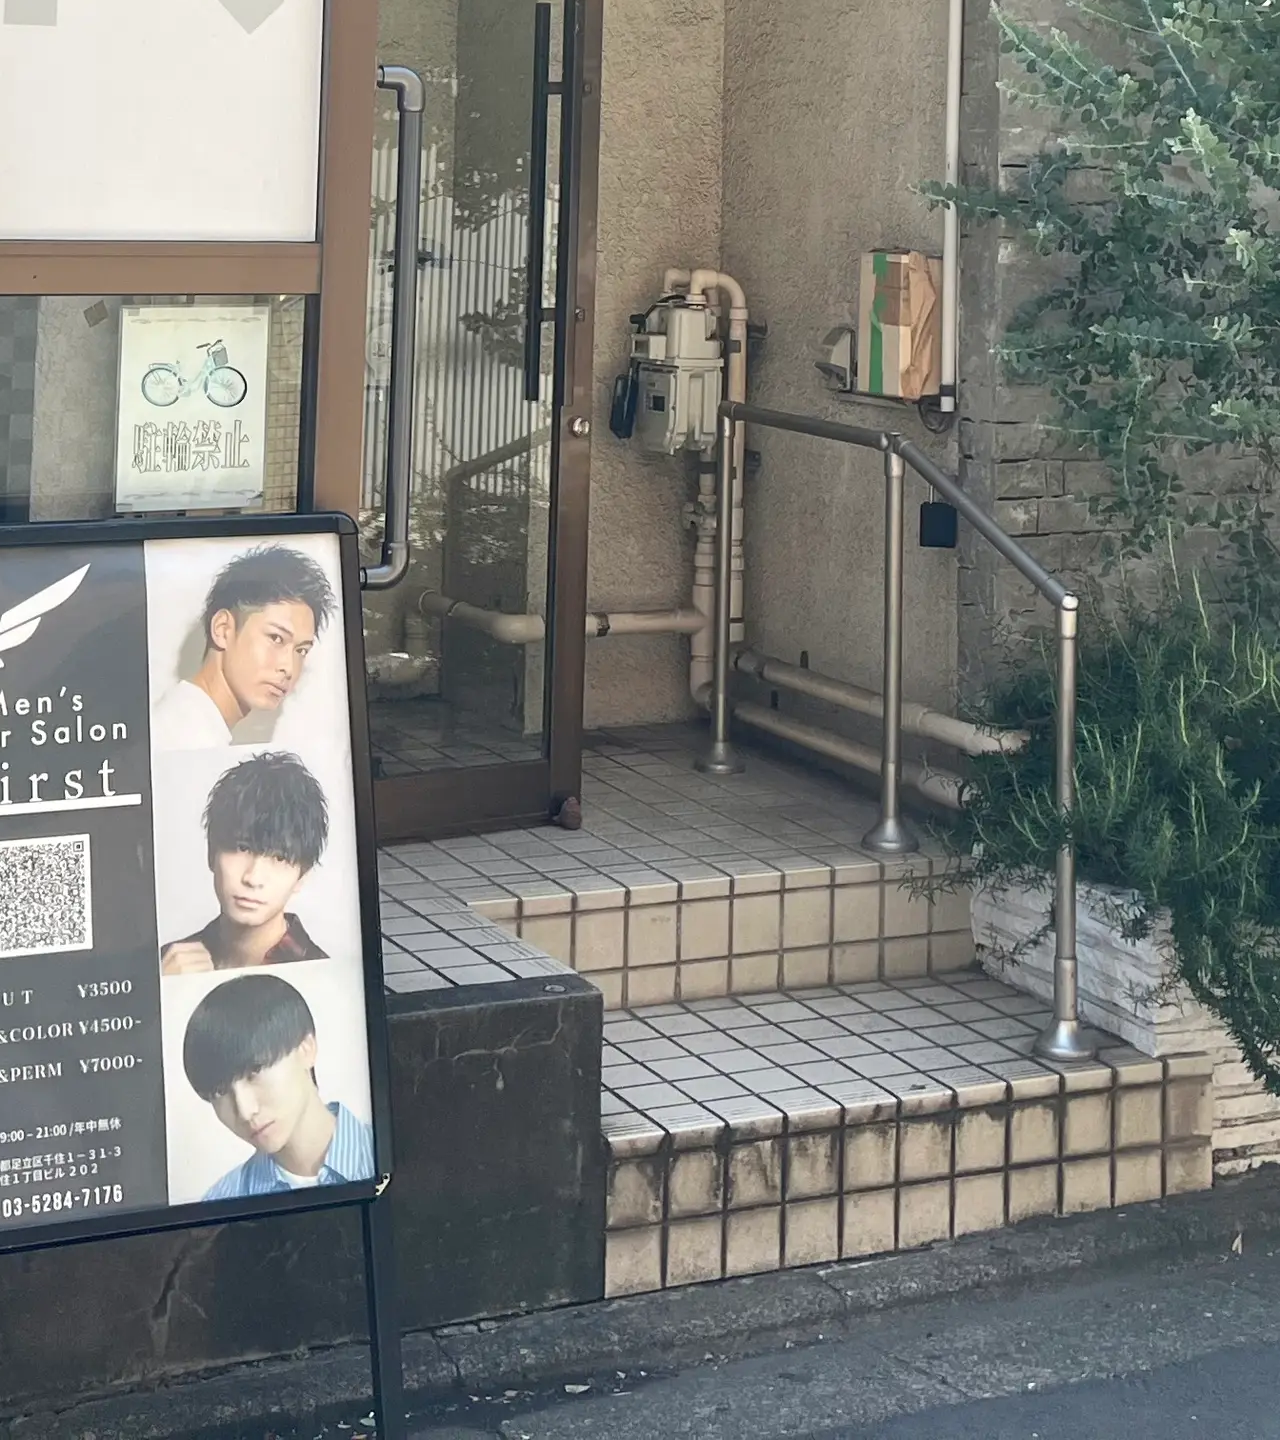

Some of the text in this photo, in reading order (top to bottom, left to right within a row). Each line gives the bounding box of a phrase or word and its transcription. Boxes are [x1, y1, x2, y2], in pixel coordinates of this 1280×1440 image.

[131, 419, 250, 474] 駐輪禁止
[30, 715, 128, 747] Salon
[77, 979, 133, 999] ¥3500
[0, 1129, 25, 1144] 9:00
[35, 1124, 67, 1139] 21:00
[2, 1184, 123, 1219] 03-5284-7176
